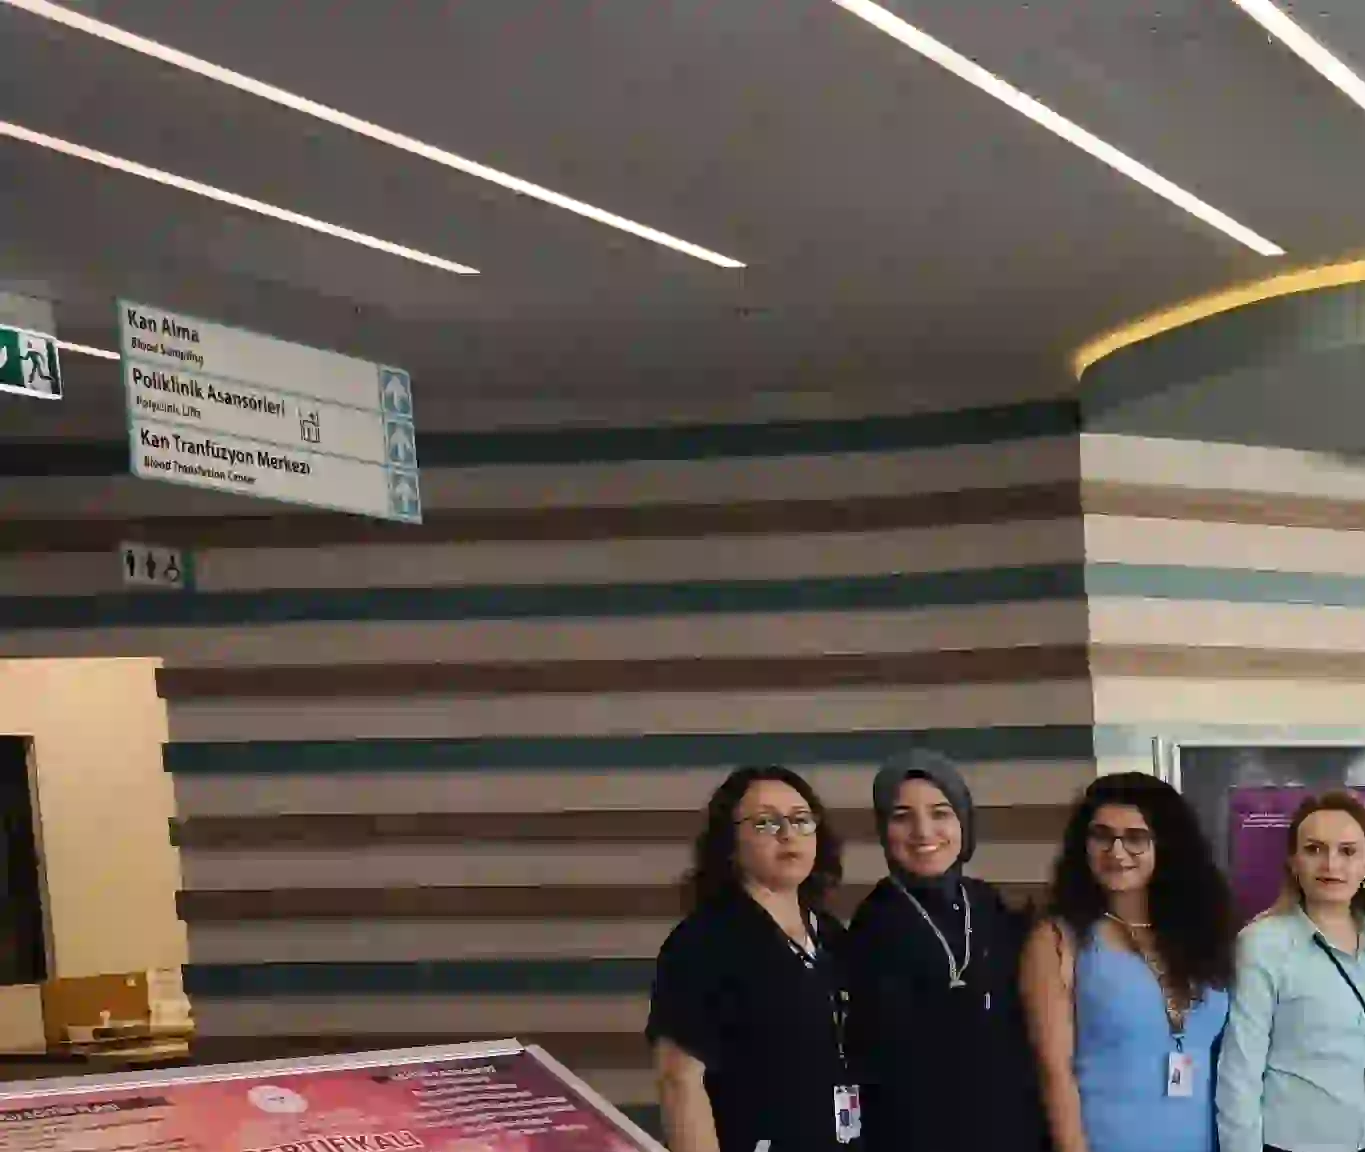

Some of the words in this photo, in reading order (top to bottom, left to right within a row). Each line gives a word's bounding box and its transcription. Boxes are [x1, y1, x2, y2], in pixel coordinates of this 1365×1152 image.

[127, 308, 157, 333] Kan
[161, 316, 200, 343] Alma
[132, 366, 205, 400] Poliklinik
[140, 427, 170, 450] Kan
